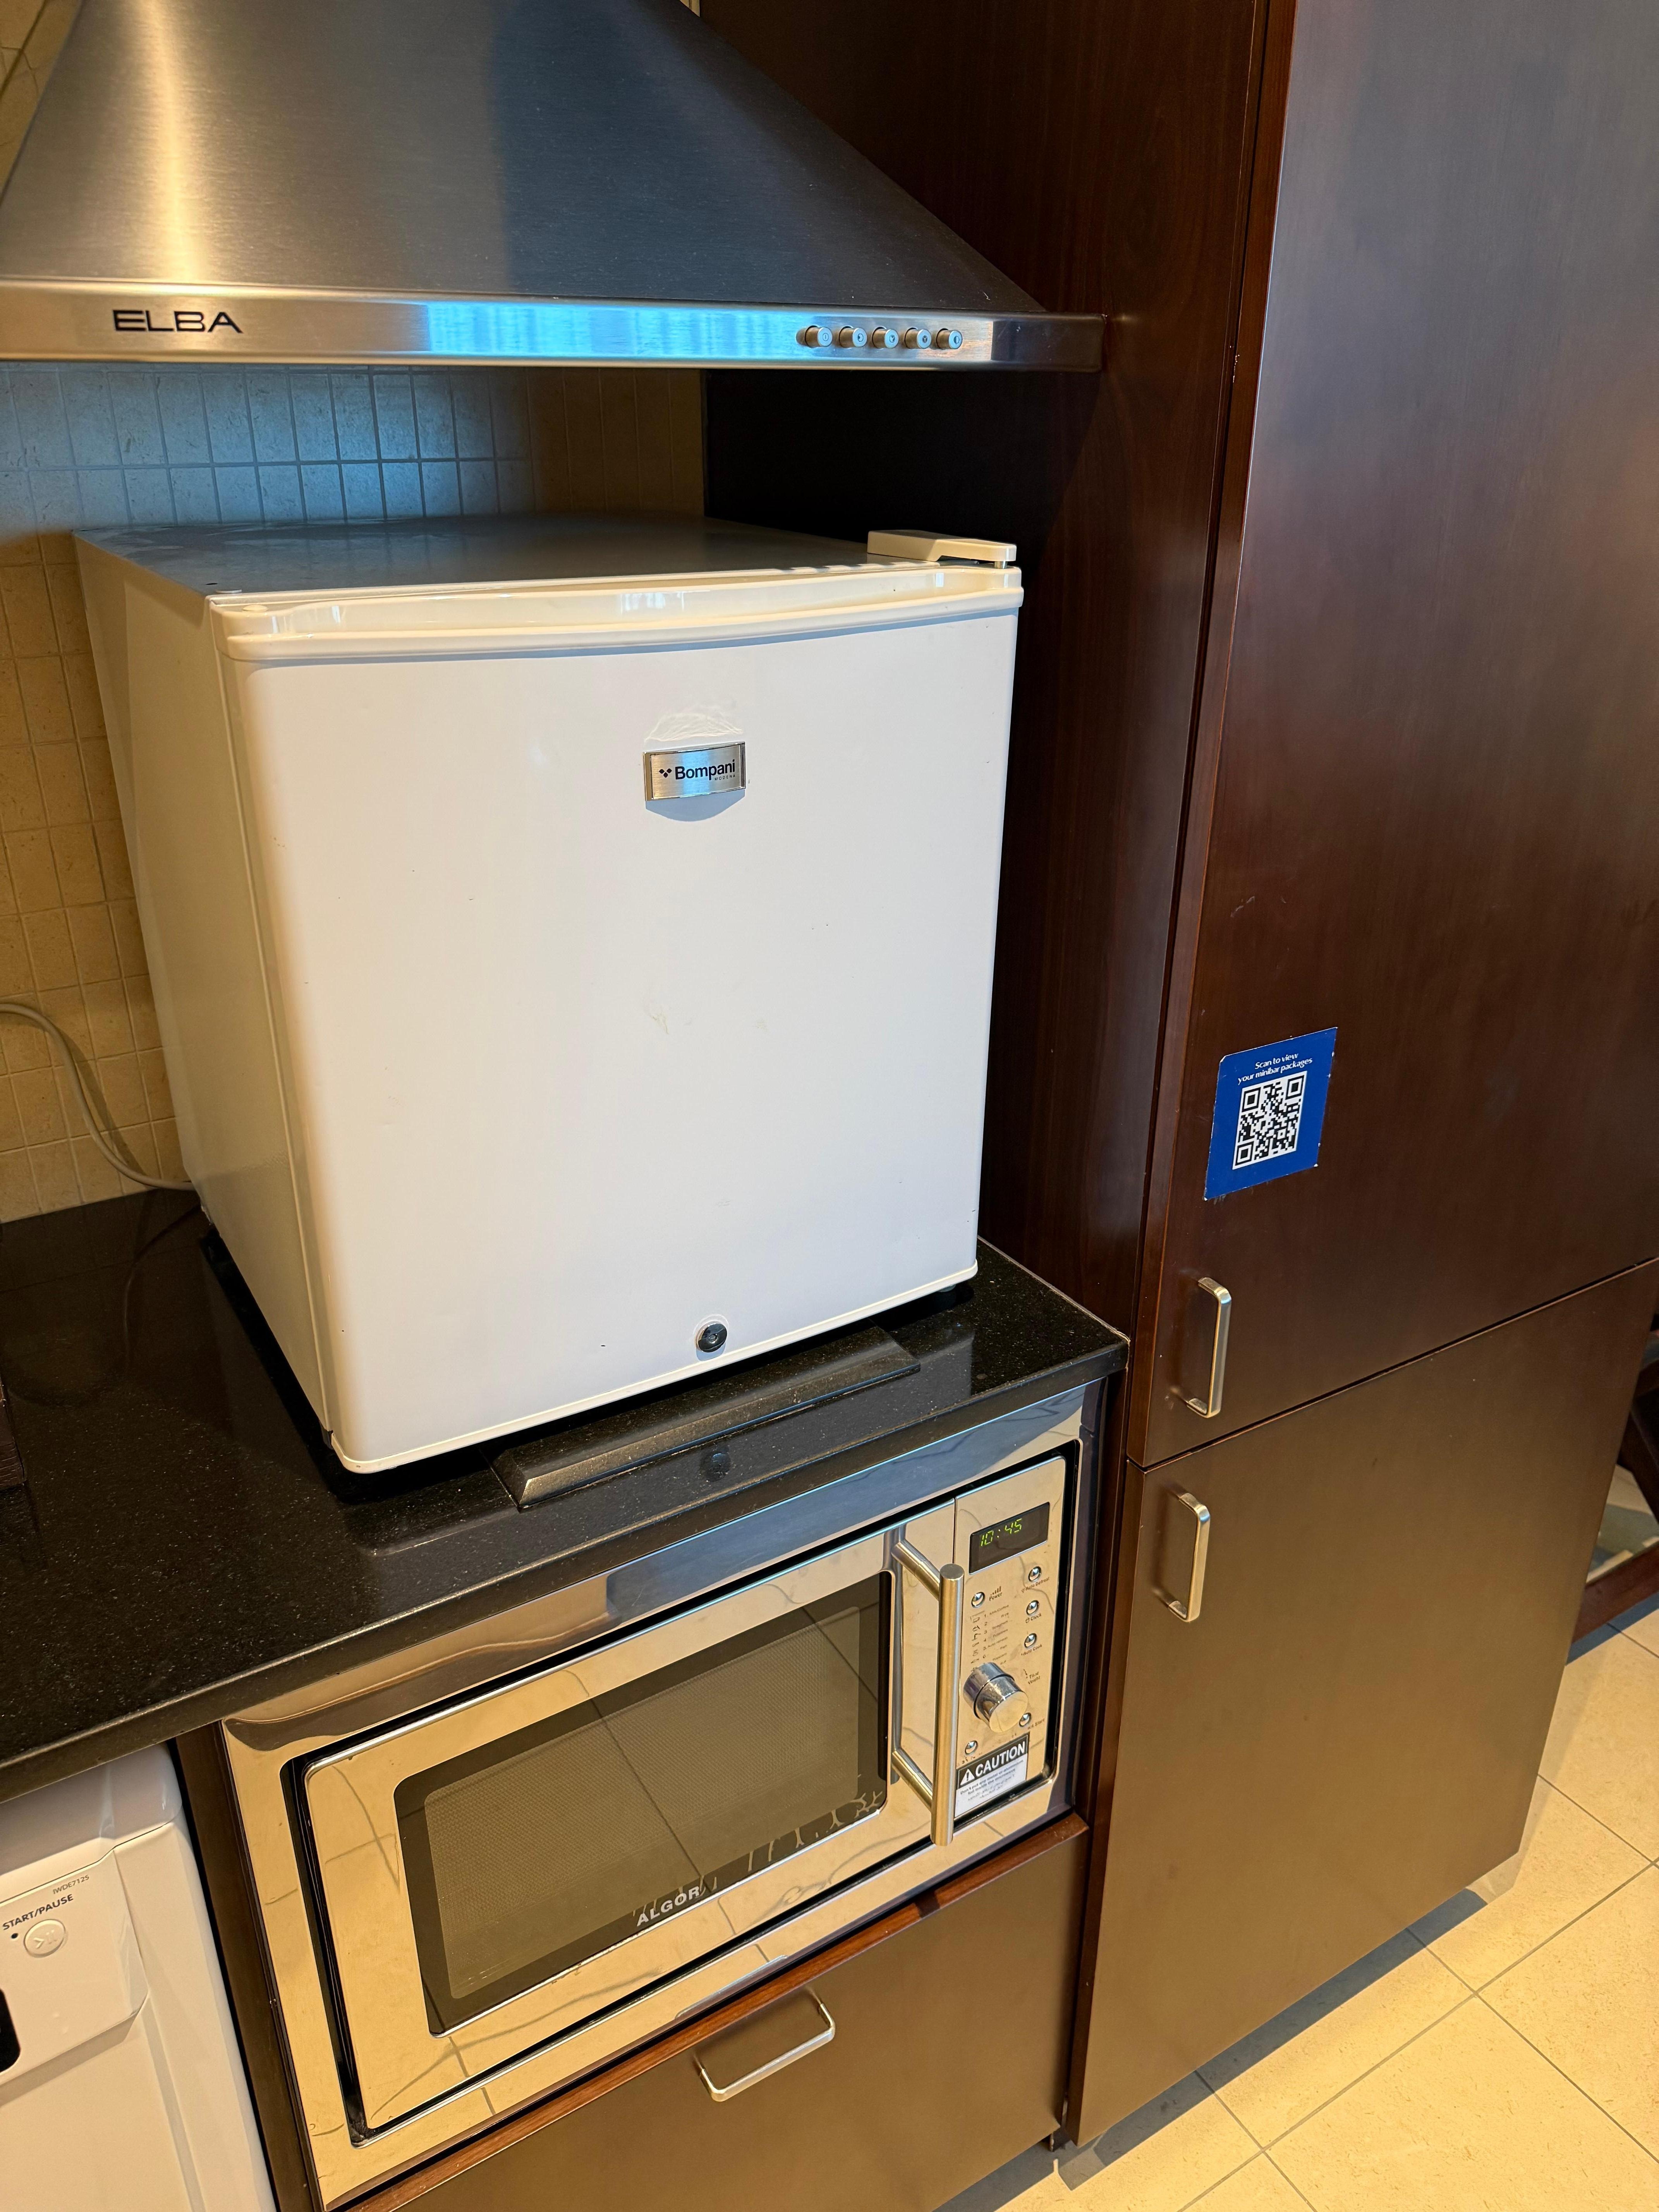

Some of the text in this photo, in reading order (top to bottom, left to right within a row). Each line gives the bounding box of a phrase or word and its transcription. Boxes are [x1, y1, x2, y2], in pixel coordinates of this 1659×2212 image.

[113, 310, 243, 333] ELBA
[675, 759, 735, 781] Bompani
[1238, 1058, 1313, 1085] your minibar packages
[1255, 1061, 1272, 1069] Scan
[1281, 1053, 1299, 1062] view
[981, 1518, 1022, 1546] 10:45
[989, 1592, 1002, 1601] Power
[975, 1741, 1025, 1777] CAUTION
[53, 1875, 89, 1894] IWDE7125
[2, 1894, 74, 1930] START/PAUSE
[637, 1886, 699, 1927] ALGOR
